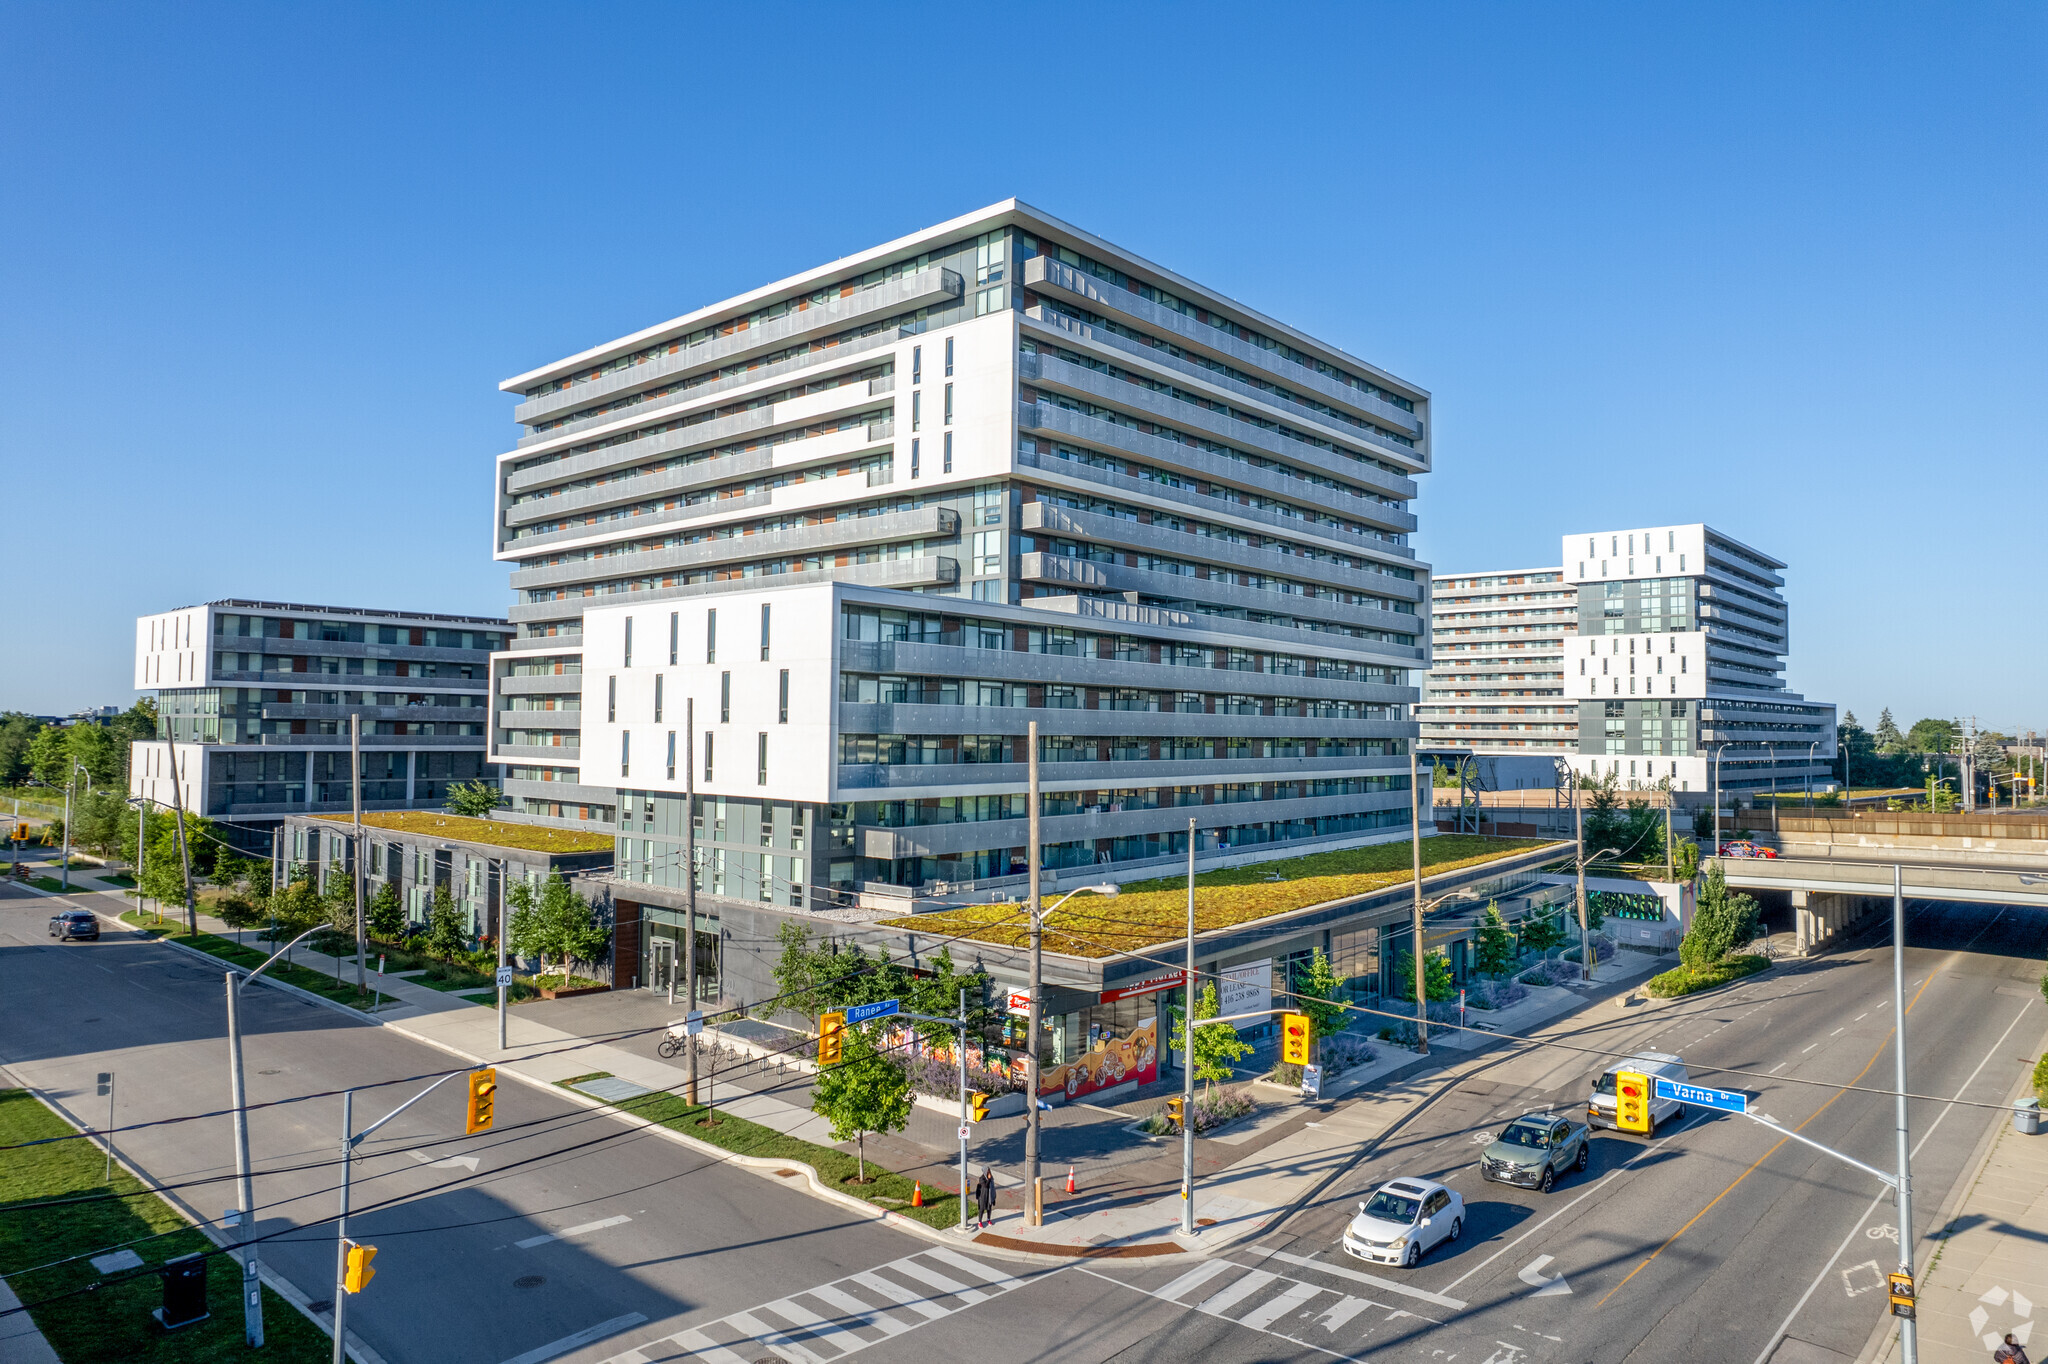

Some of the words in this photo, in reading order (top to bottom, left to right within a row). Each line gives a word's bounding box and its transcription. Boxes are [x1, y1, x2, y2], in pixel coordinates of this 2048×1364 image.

[498, 974, 511, 984] 40
[855, 1006, 881, 1018] Ranee
[1673, 1084, 1713, 1102] Varna
[1720, 1092, 1729, 1100] Dr
